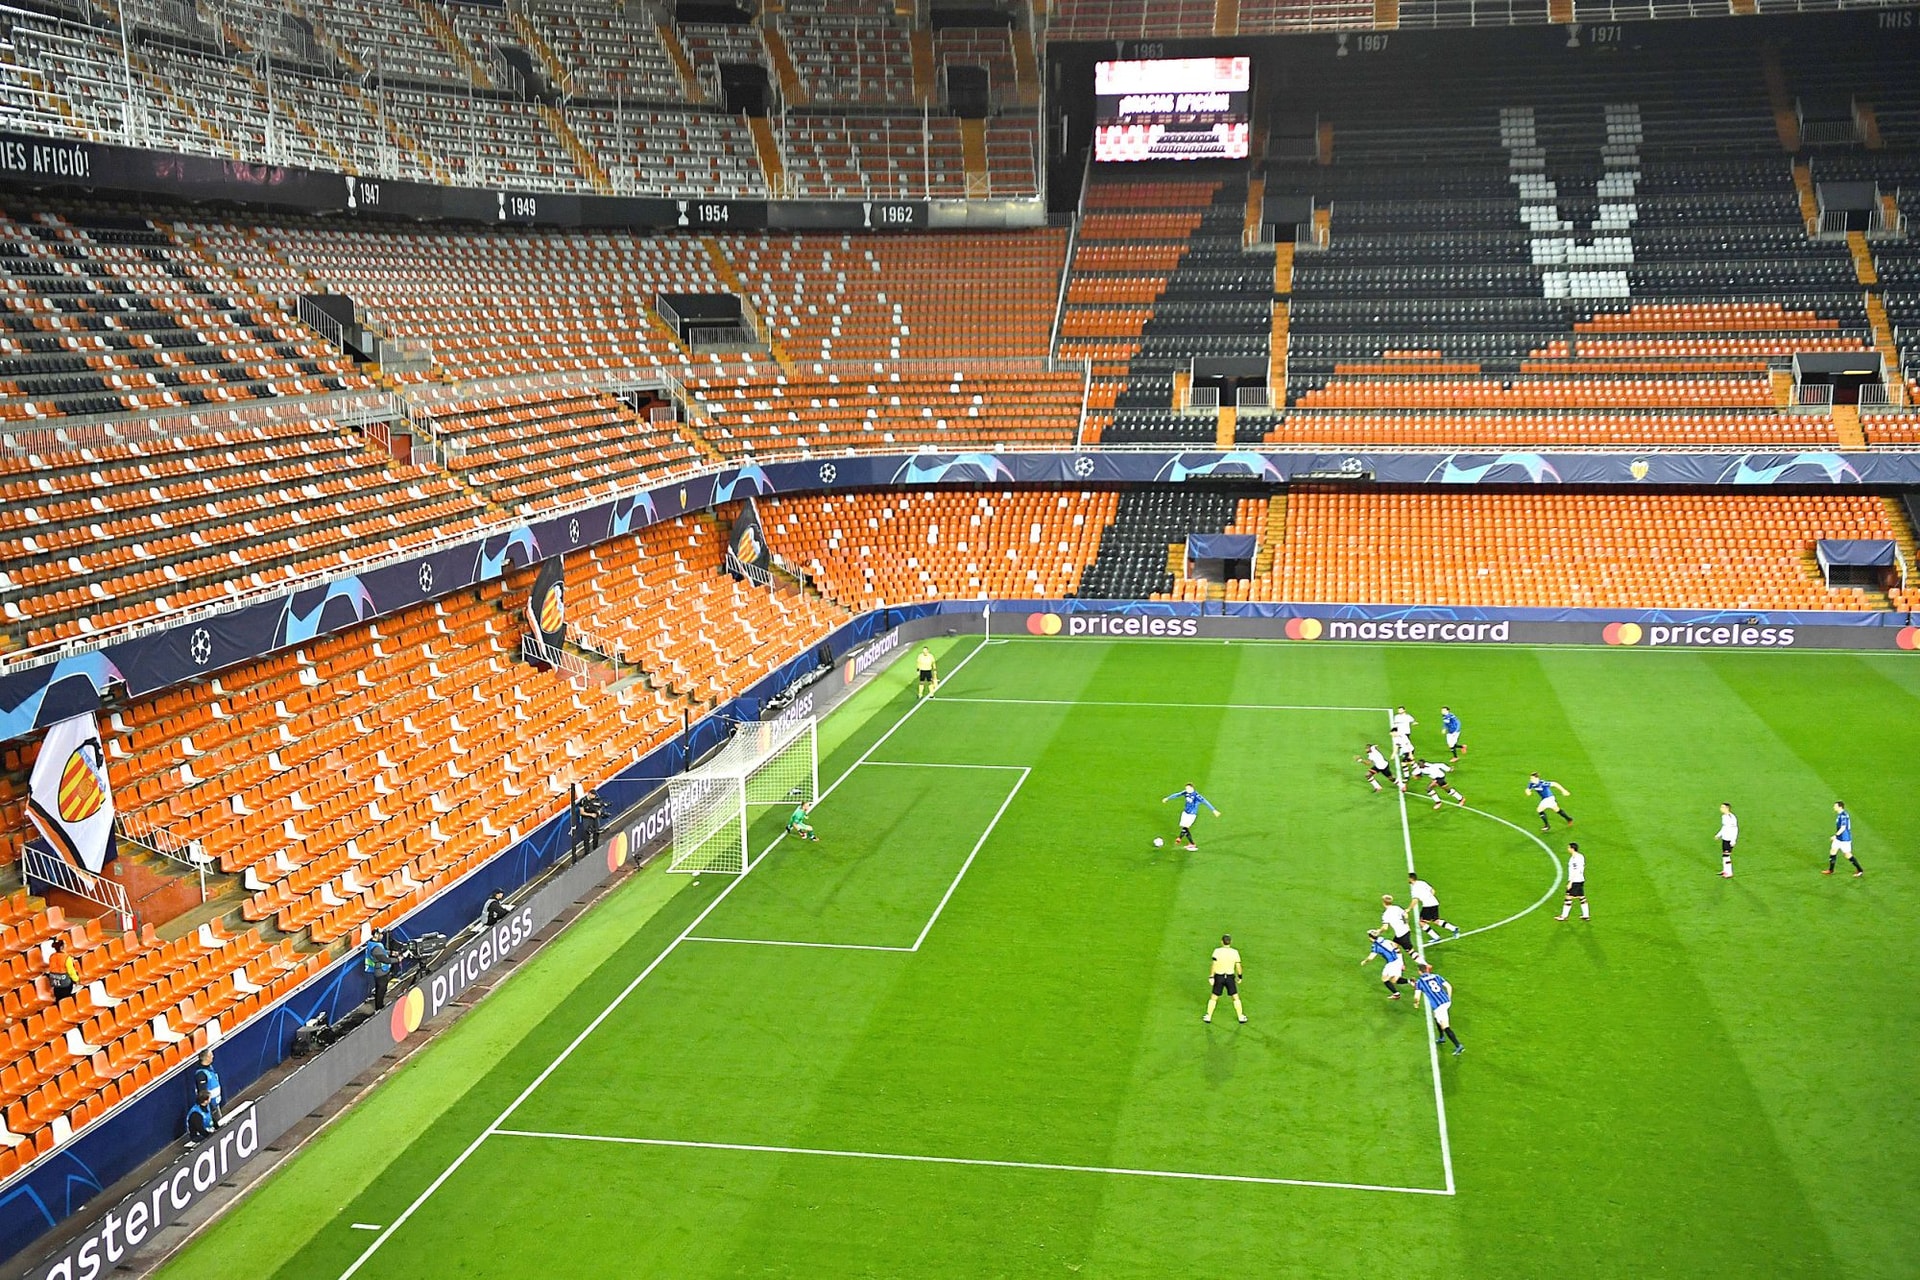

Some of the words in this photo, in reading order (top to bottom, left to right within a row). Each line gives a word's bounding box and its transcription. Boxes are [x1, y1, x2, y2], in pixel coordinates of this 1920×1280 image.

[1878, 11, 1912, 28] THIS
[1357, 35, 1389, 51] 1967
[1591, 26, 1622, 42] 1971
[1133, 43, 1163, 58] 1963
[33, 144, 90, 177] AFICIÓ!
[360, 183, 380, 204] 1947
[511, 197, 536, 216] 1949
[698, 205, 729, 222] 1954
[881, 206, 913, 223] 1962
[1069, 613, 1198, 636] priceless
[1330, 618, 1510, 641] mastercard
[1650, 622, 1795, 646] priceless
[855, 626, 899, 675] mastercard
[772, 692, 814, 741] priceless
[631, 764, 712, 852] mastercard
[431, 906, 533, 1017] priceless
[1428, 979, 1441, 993] 8
